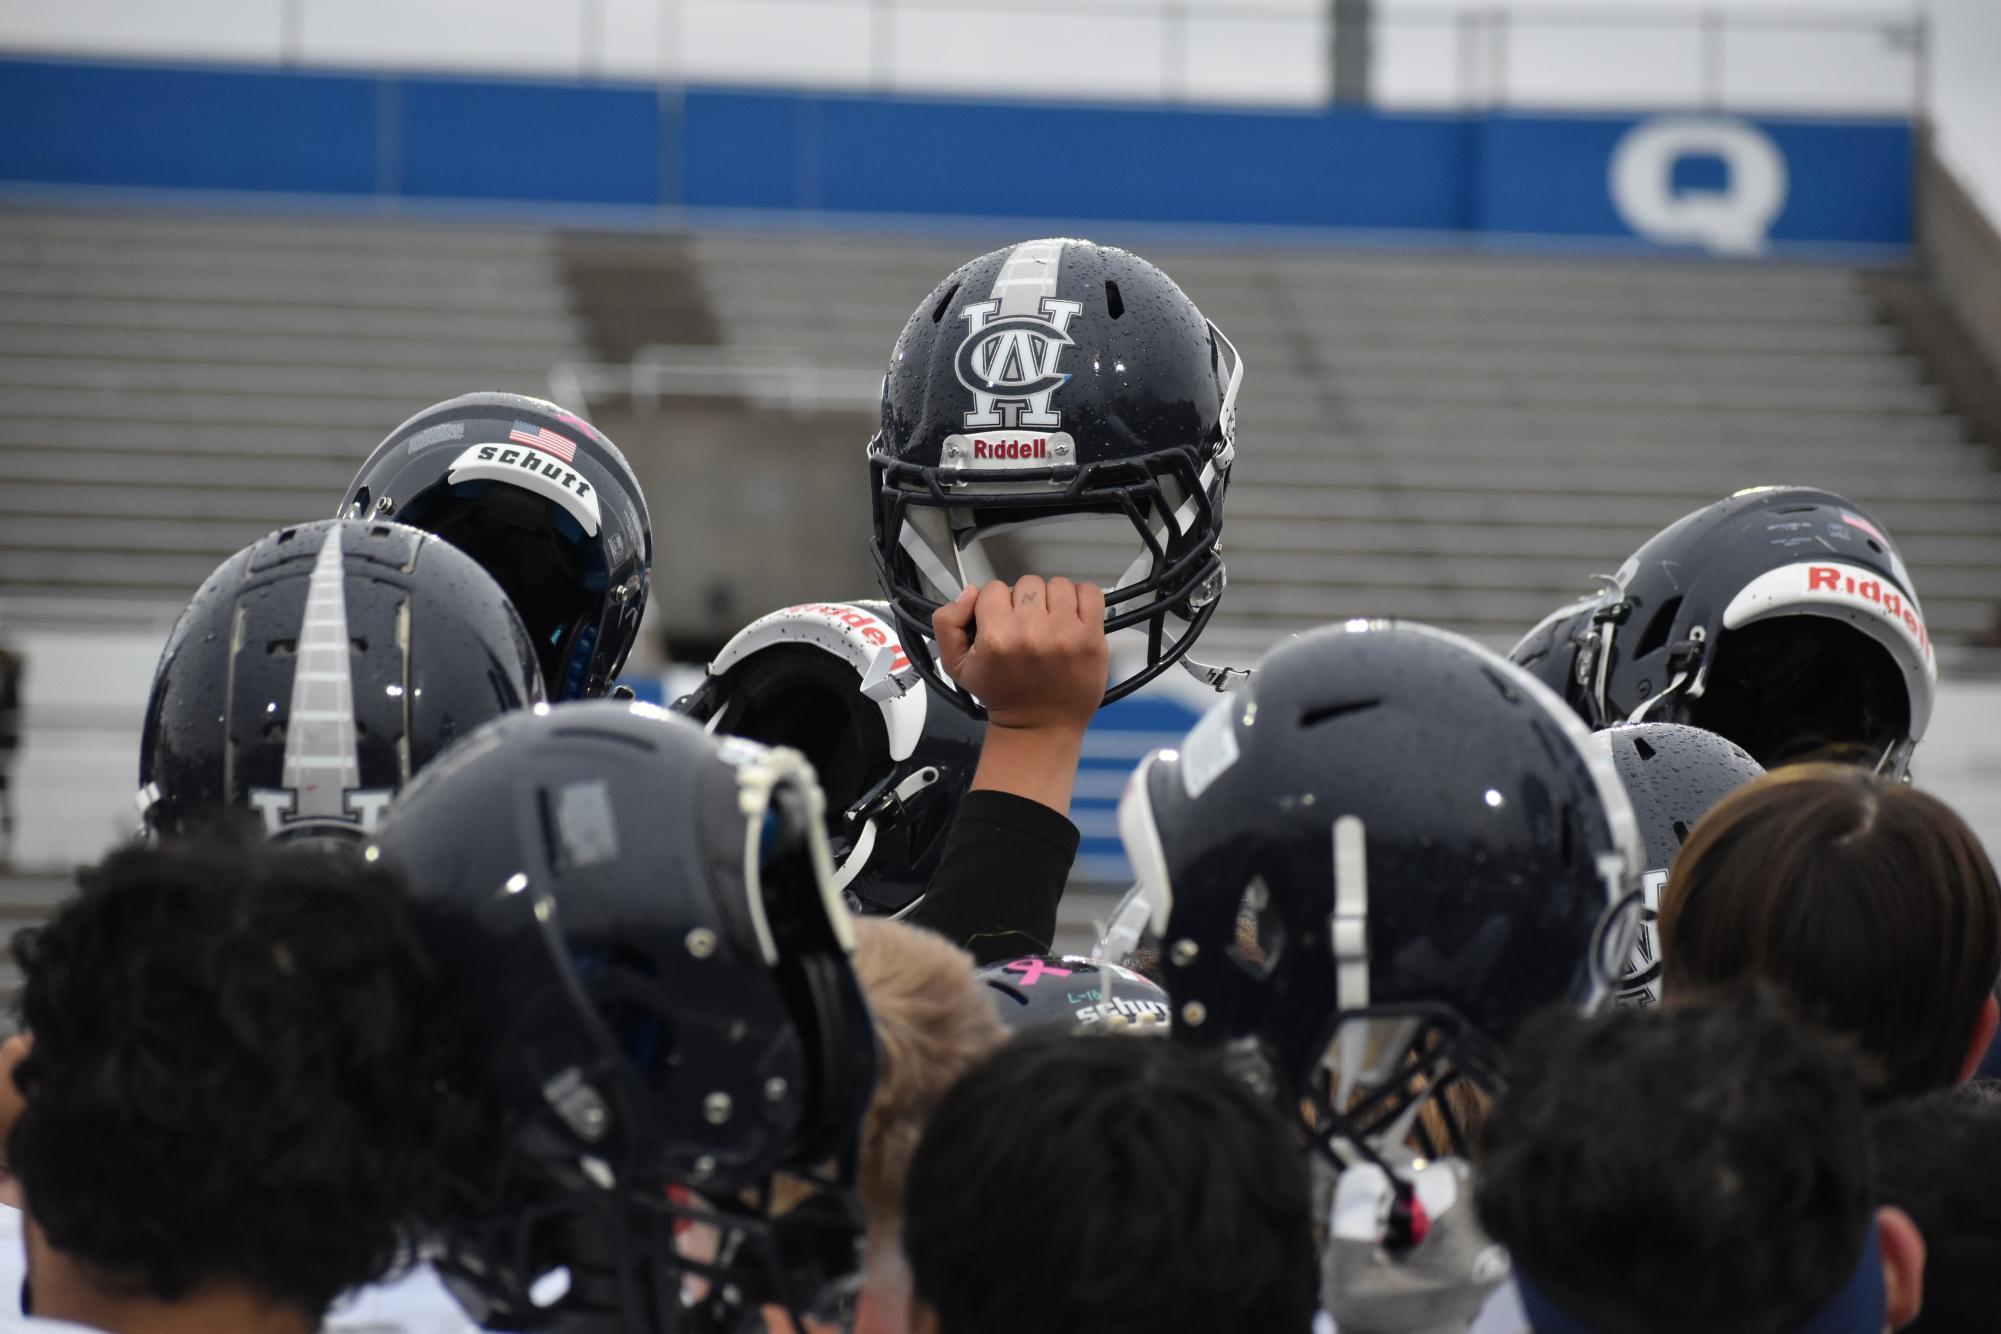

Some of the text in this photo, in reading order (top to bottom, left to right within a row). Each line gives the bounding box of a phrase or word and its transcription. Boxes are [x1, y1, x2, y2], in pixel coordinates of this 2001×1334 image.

[1609, 118, 1786, 254] Q
[477, 446, 592, 498] schutt
[973, 438, 1047, 460] Riddell
